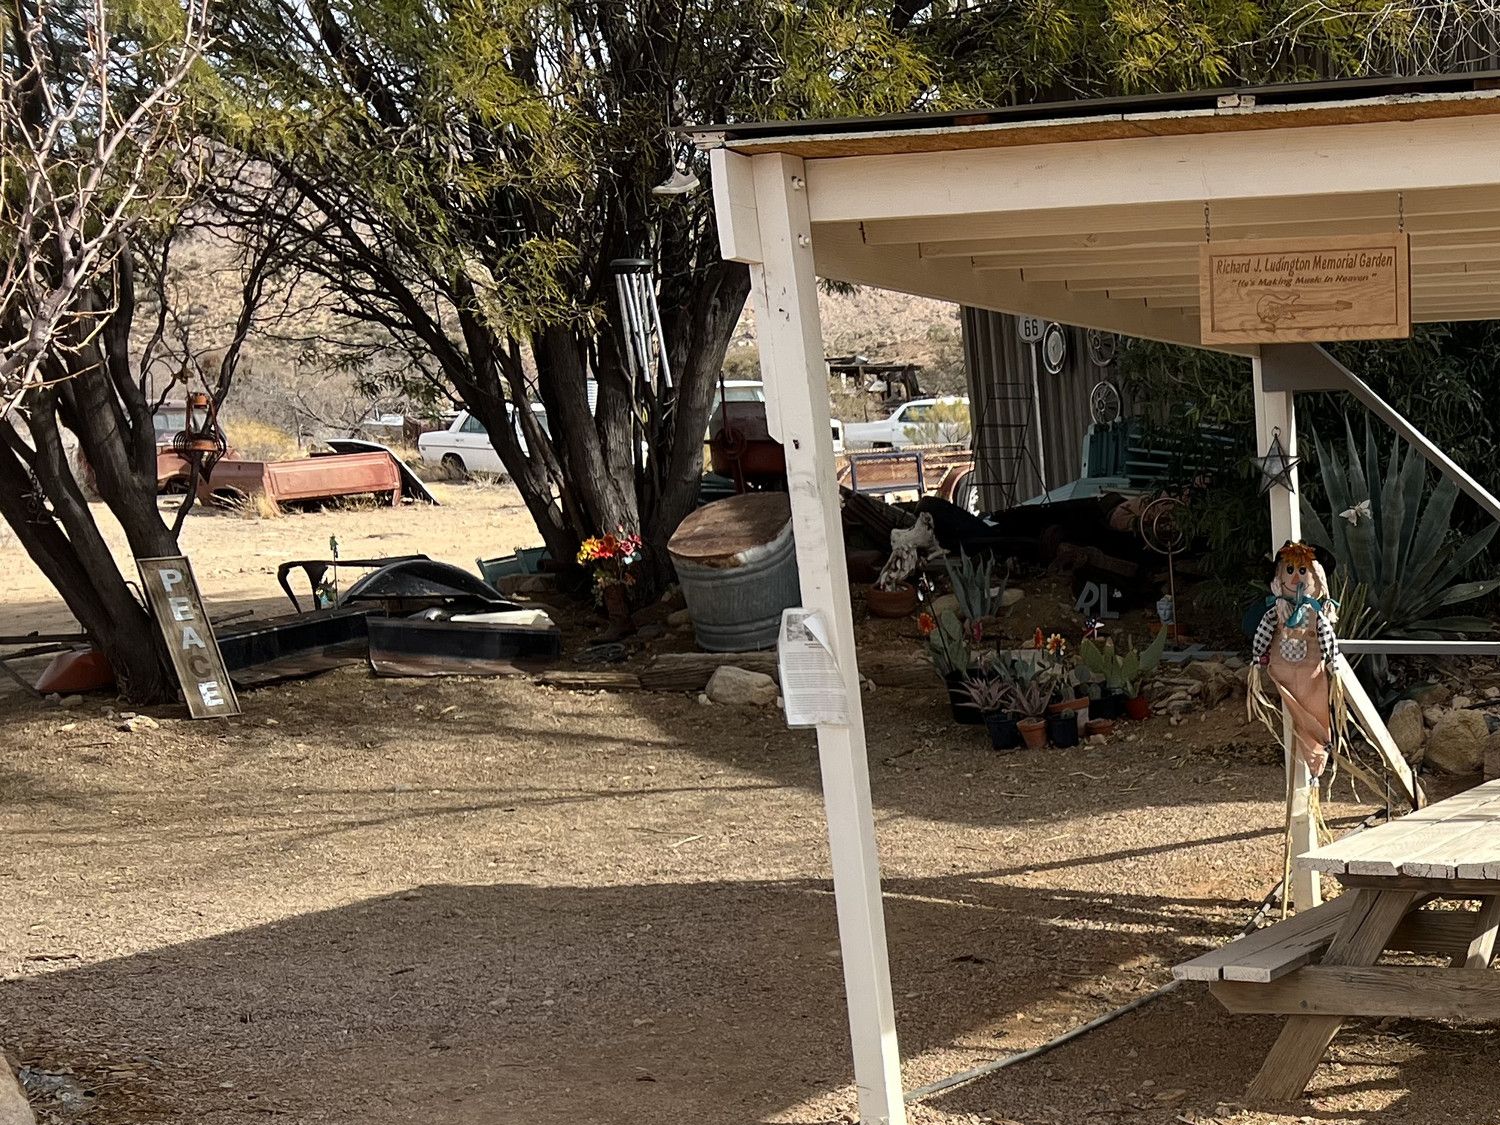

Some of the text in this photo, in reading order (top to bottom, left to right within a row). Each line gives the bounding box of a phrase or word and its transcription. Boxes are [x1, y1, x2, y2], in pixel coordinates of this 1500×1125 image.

[1216, 252, 1393, 277] Richard J. Ludington Memorial Garden
[1257, 278, 1293, 288] Making
[1295, 275, 1321, 284] Music
[1024, 318, 1039, 337] 66
[158, 568, 225, 707] PEACE
